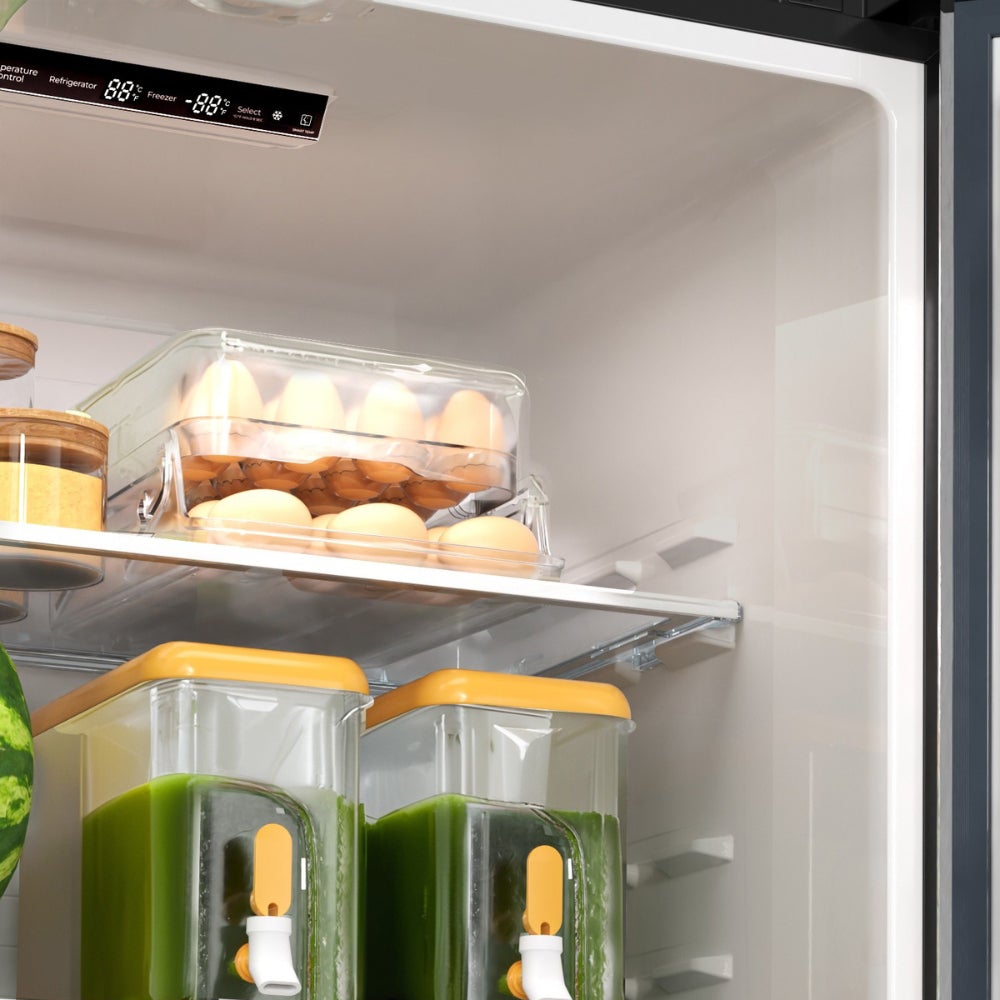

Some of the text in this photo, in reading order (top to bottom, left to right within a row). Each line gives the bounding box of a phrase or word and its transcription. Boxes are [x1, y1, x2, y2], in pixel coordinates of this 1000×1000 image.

[48, 75, 98, 90] Refrigerator
[103, 78, 134, 102] 88
[147, 91, 177, 102] Freezer
[237, 105, 261, 116] Select
